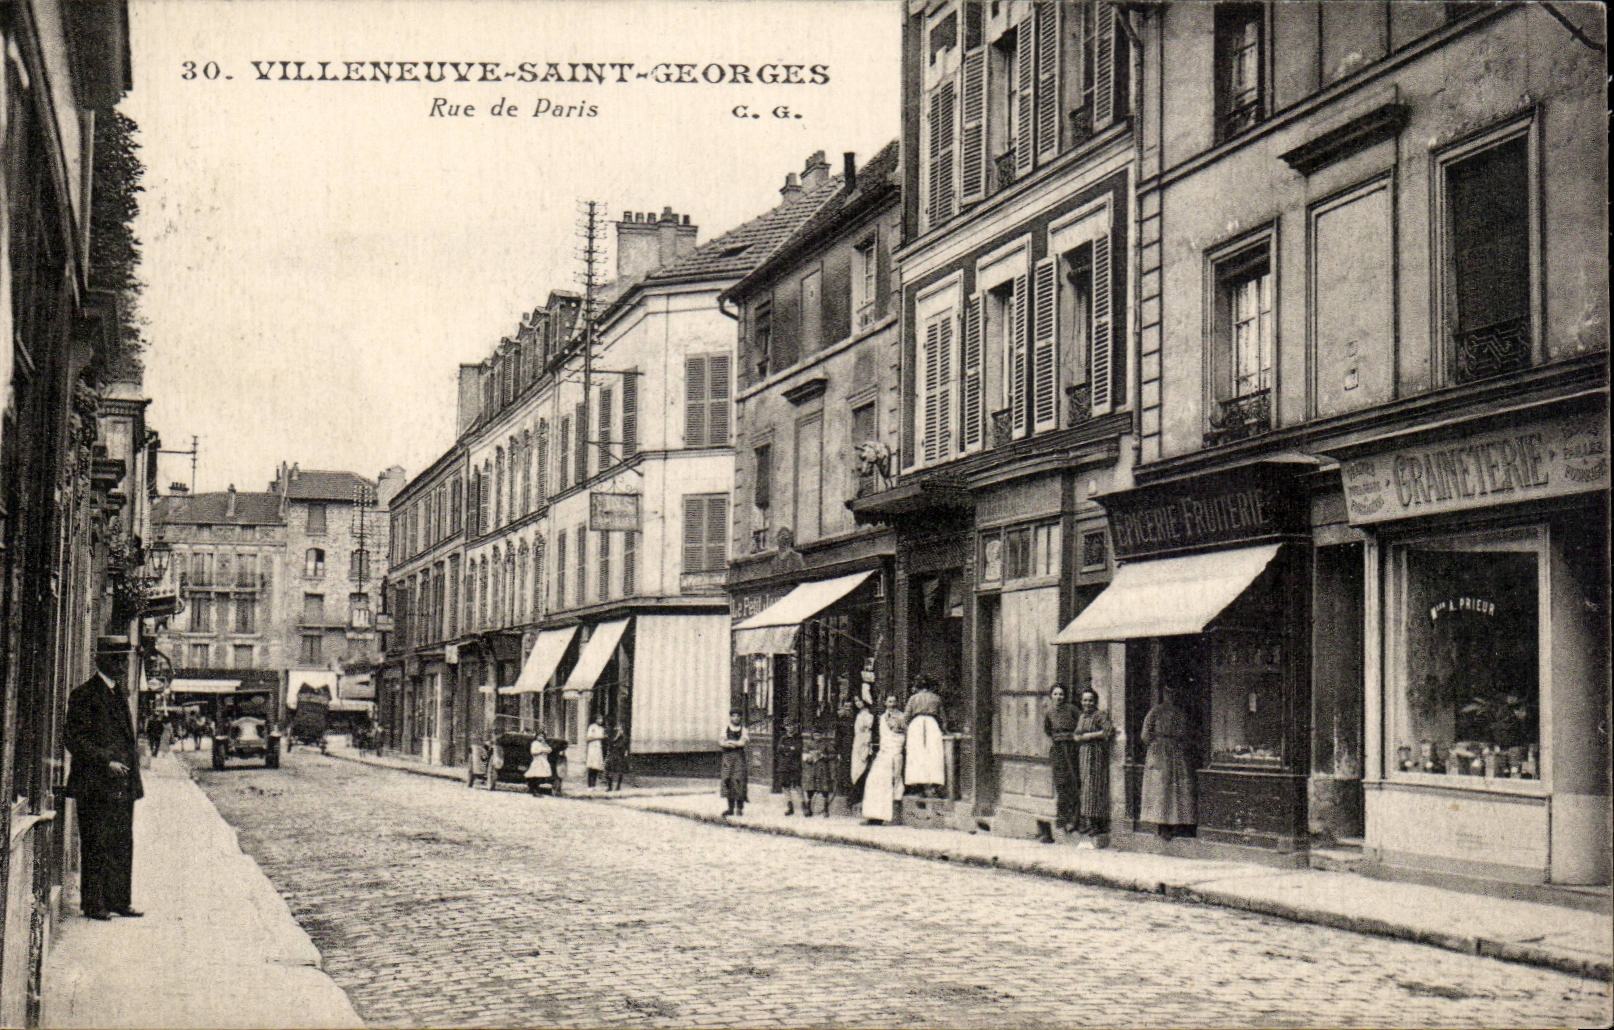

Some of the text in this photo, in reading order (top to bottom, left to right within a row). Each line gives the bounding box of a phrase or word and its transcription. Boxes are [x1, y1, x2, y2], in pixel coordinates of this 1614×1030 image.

[1393, 431, 1549, 508] GRAINETERIE
[1181, 489, 1270, 536] FRUITERIE
[1459, 597, 1495, 617] PRIEUR
